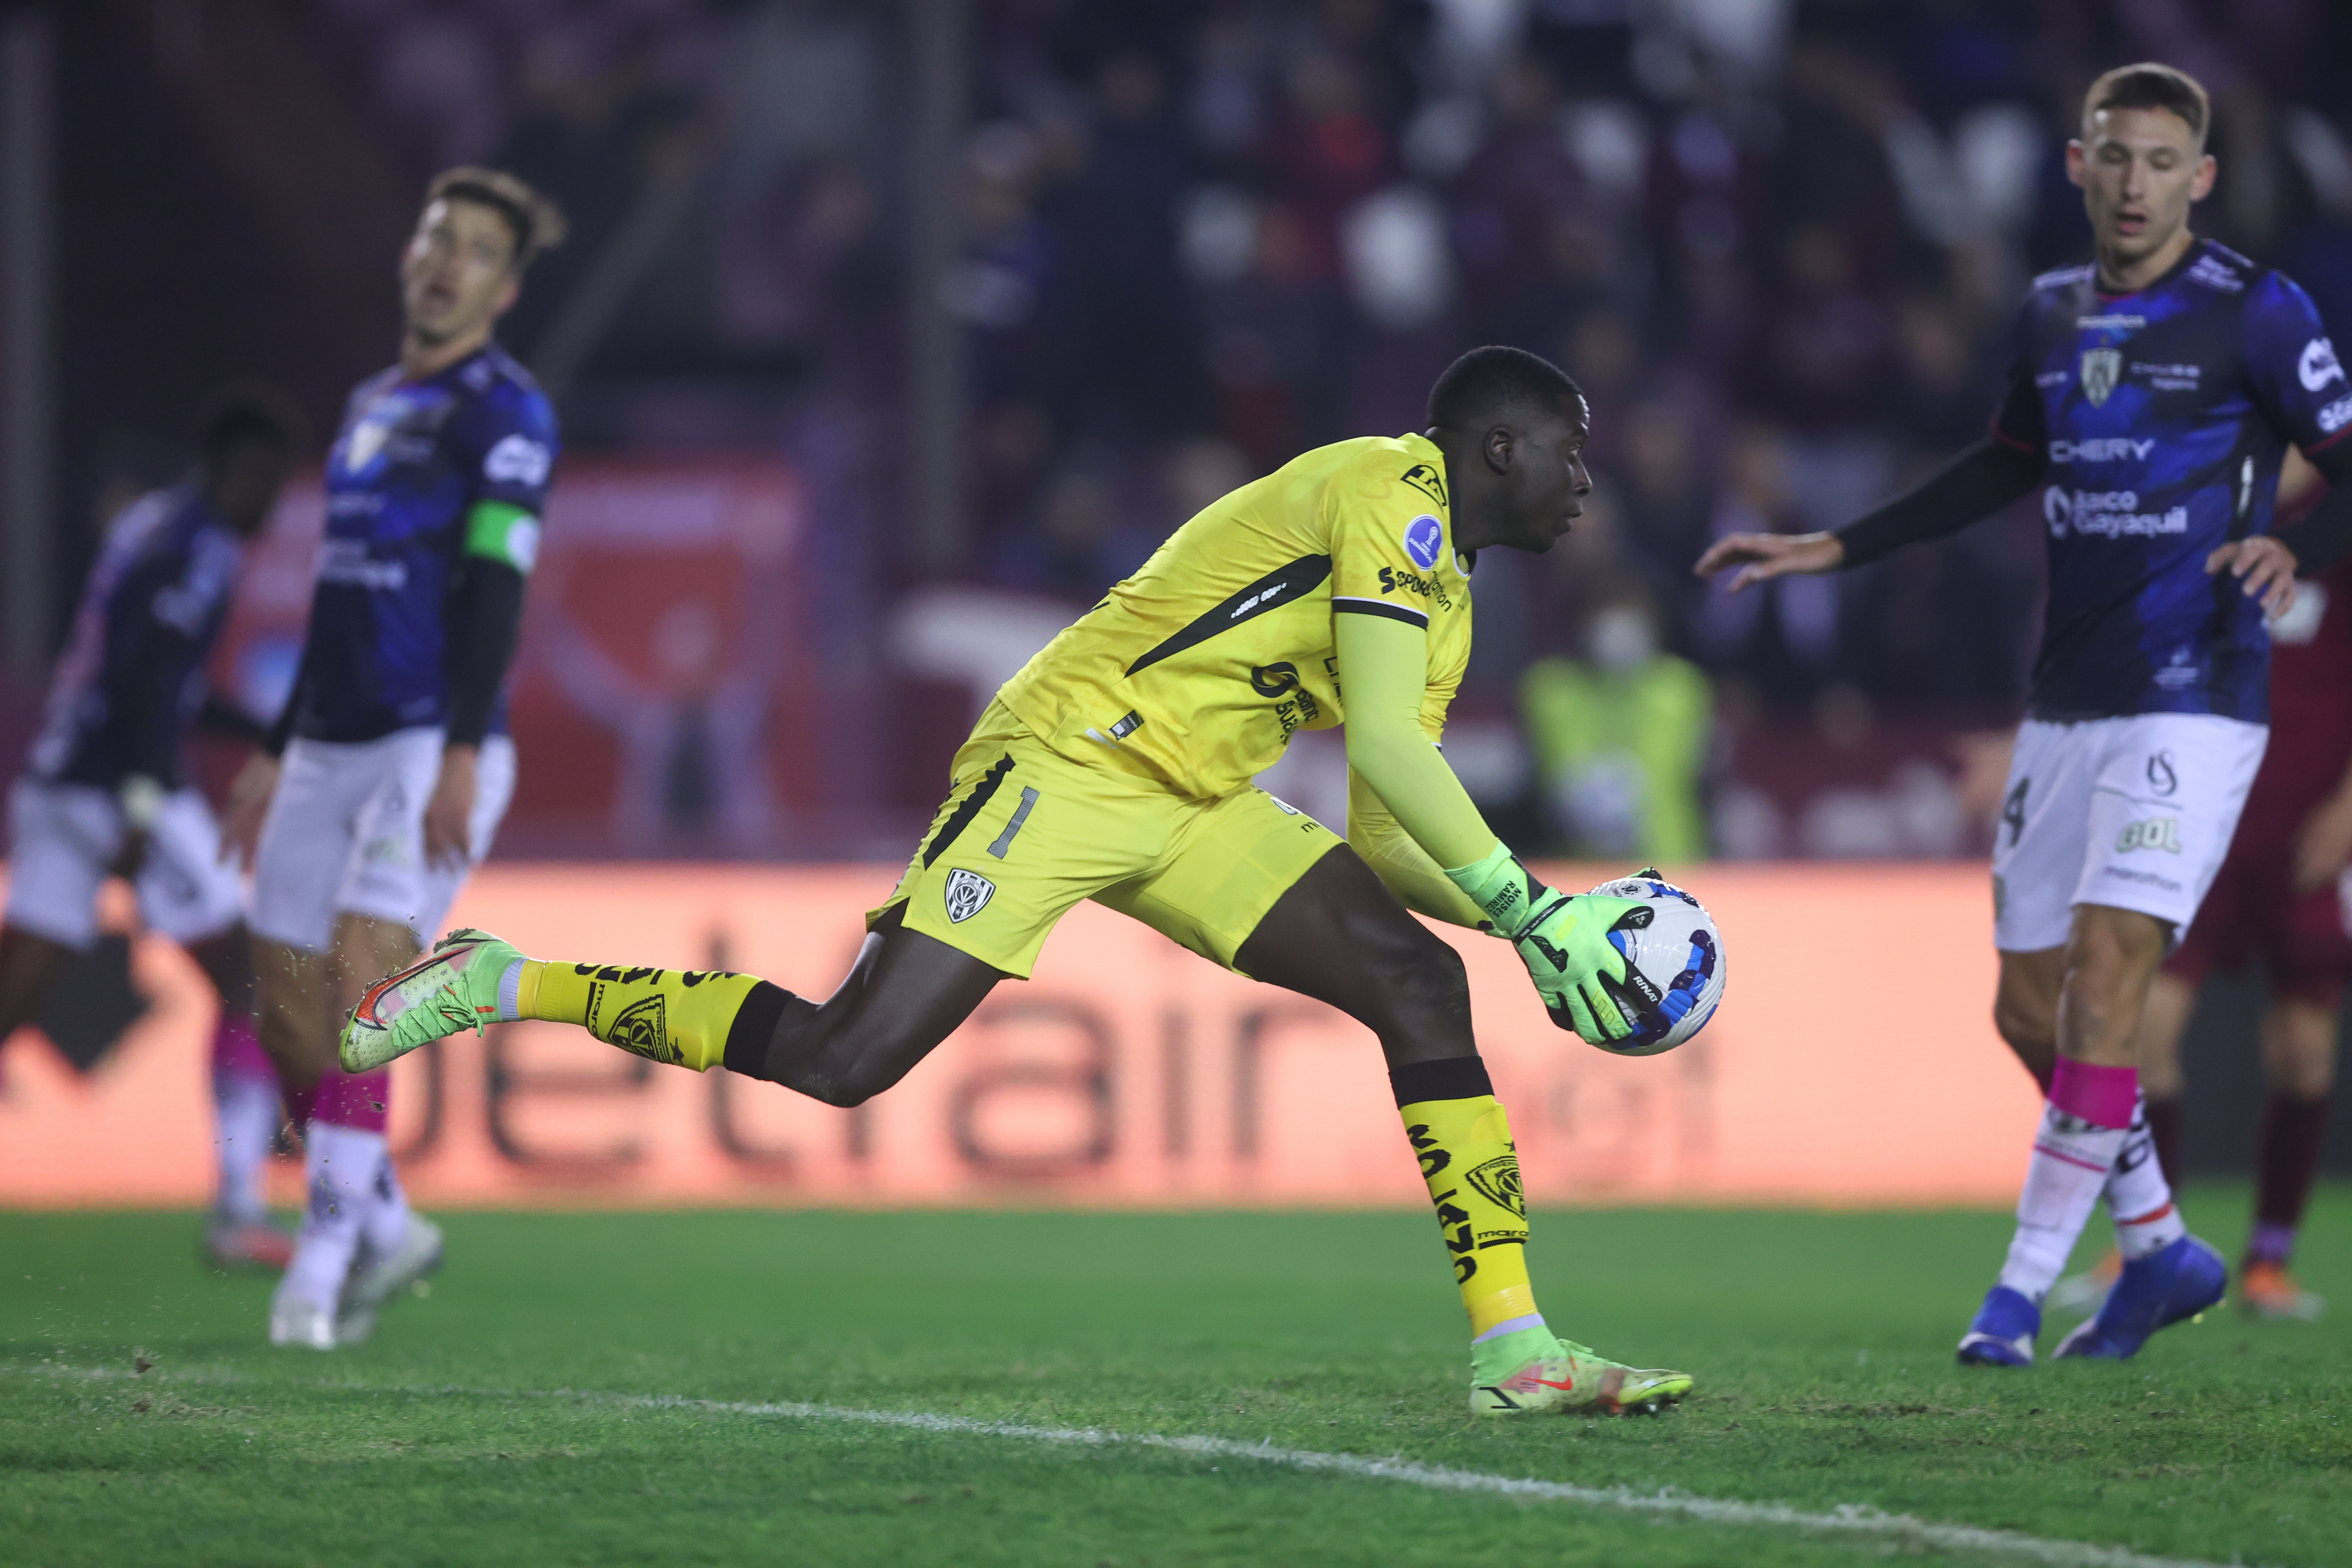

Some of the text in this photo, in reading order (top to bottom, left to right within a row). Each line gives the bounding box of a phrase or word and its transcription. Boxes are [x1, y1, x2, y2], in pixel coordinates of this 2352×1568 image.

[986, 785, 1040, 860] 1
[2003, 777, 2030, 848] 4
[1492, 887, 1522, 918] MOISES
[1633, 975, 1658, 1002] RINAT
